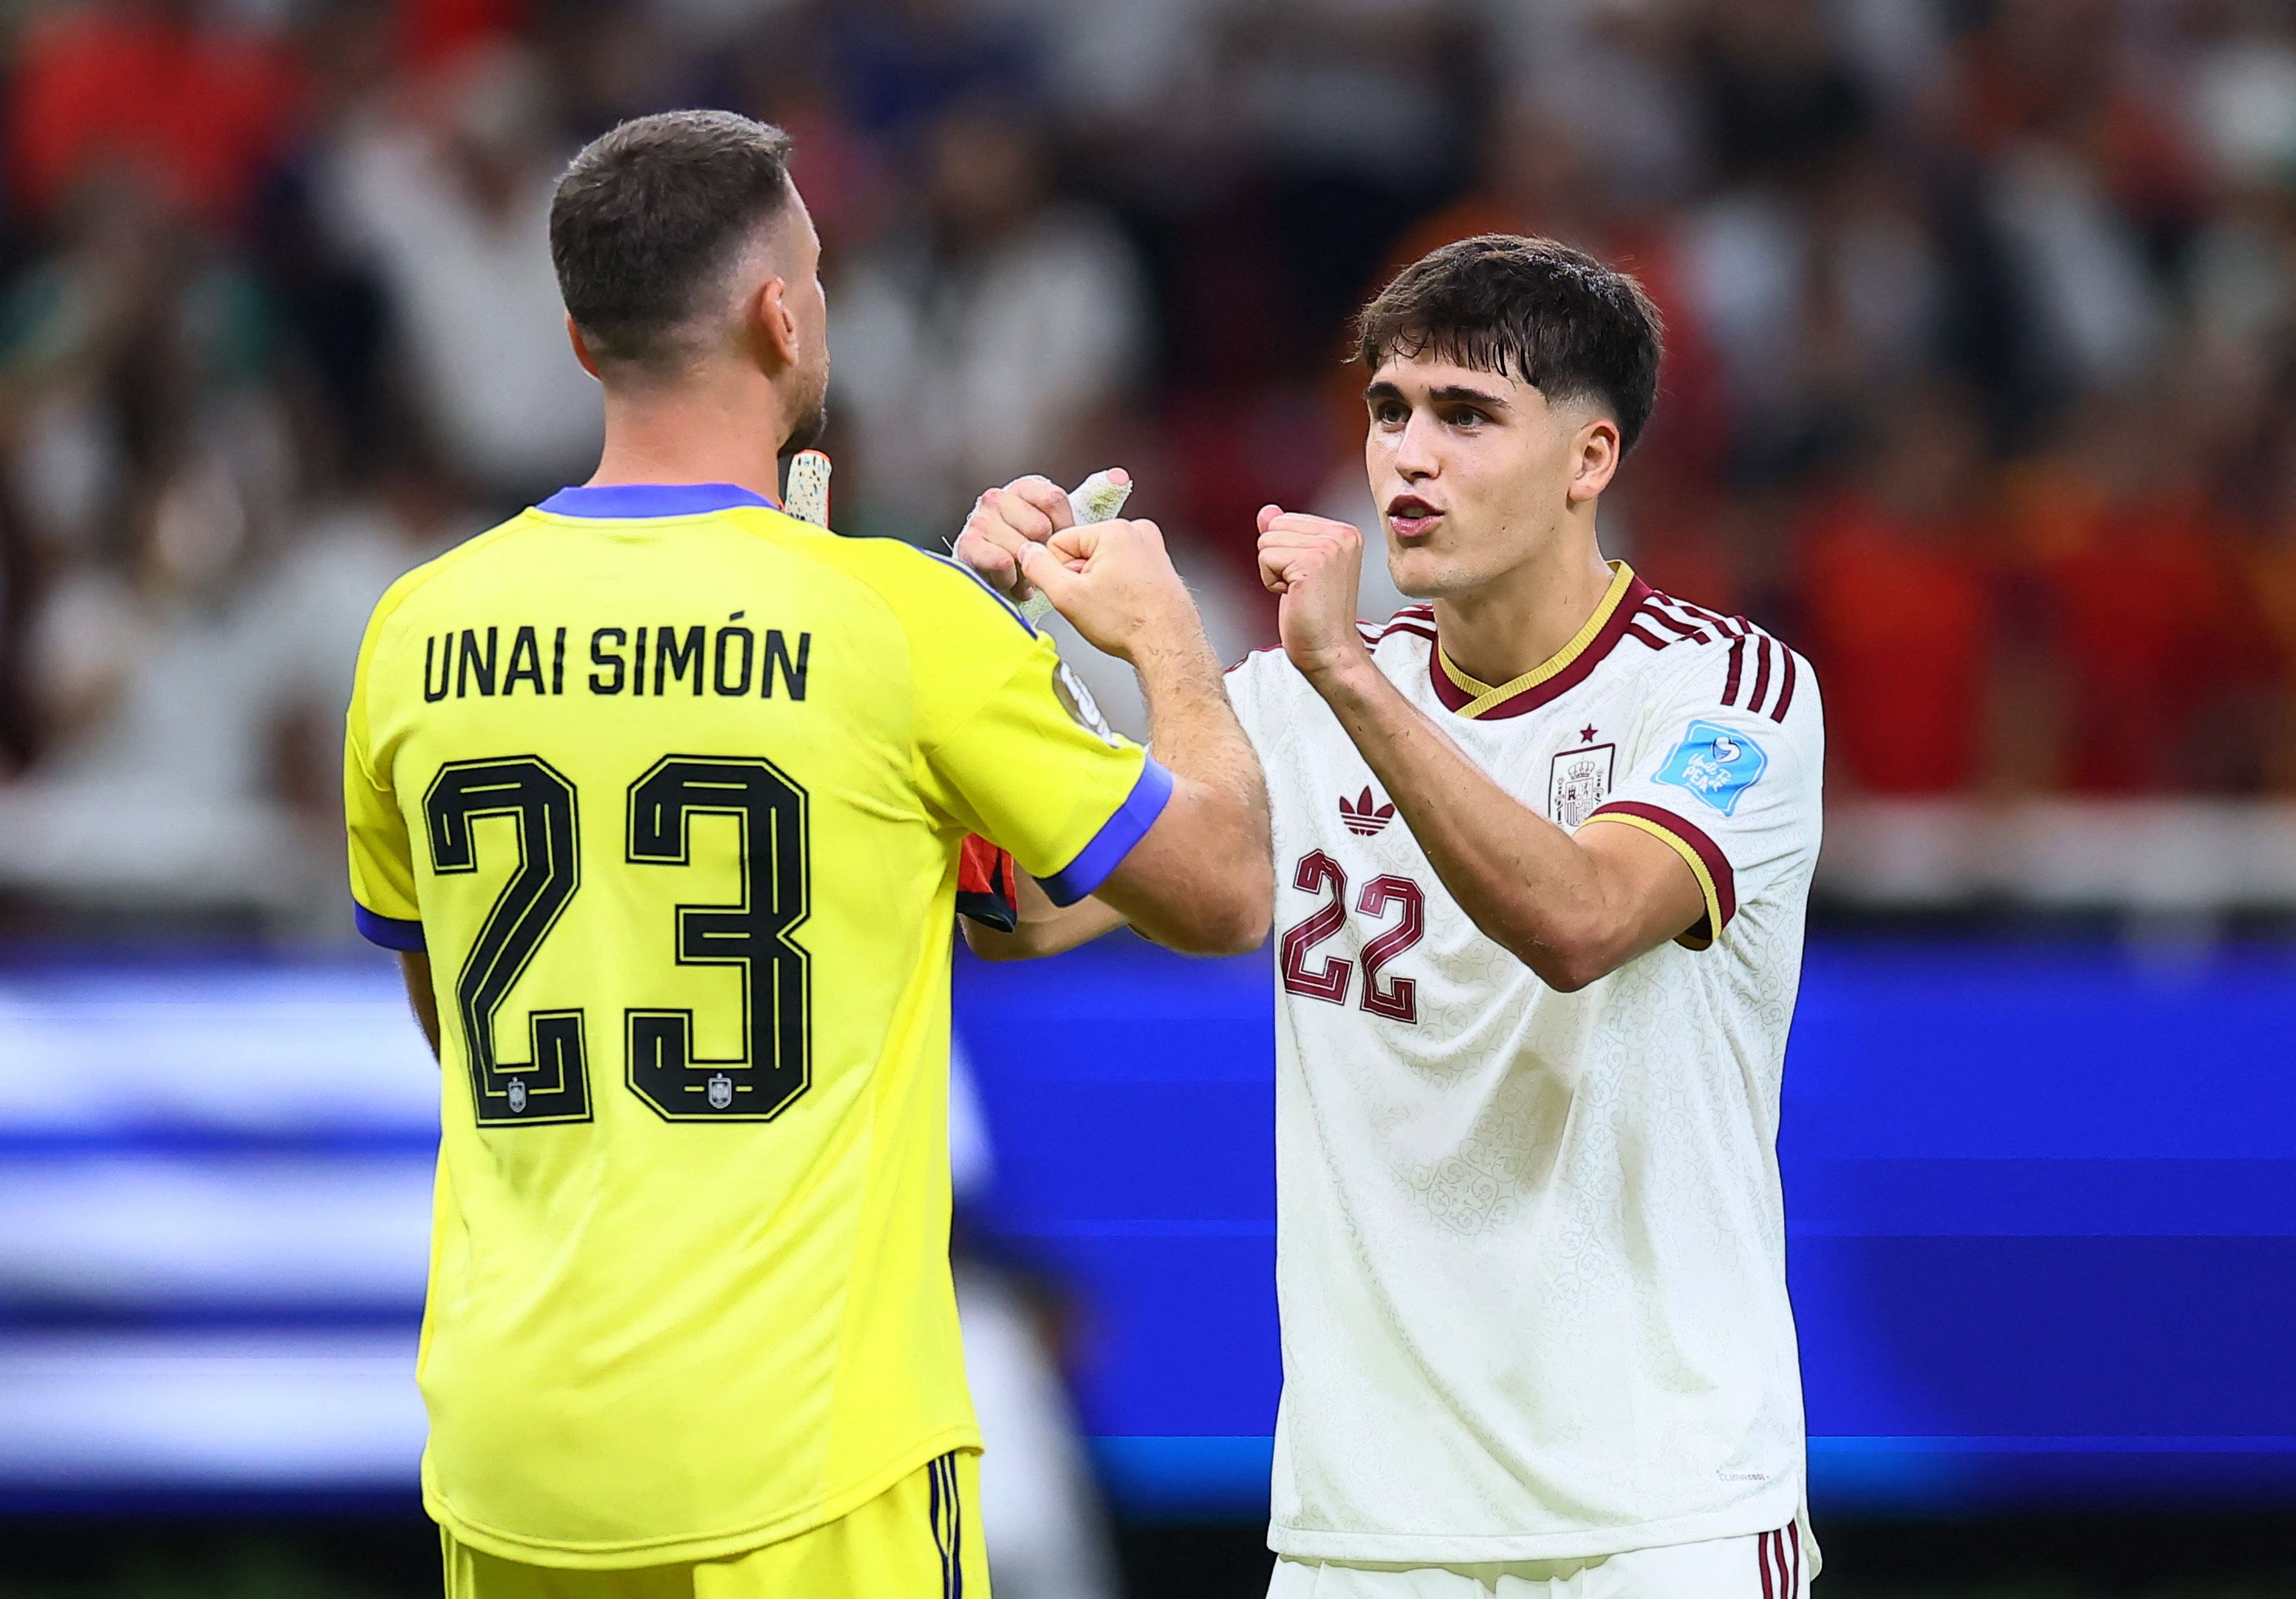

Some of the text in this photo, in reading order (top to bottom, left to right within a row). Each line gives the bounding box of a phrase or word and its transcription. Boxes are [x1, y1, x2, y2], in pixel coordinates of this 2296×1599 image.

[424, 610, 811, 703] UNAI SIMÓN
[422, 754, 810, 1128] 23
[1280, 848, 1425, 1024] 22
